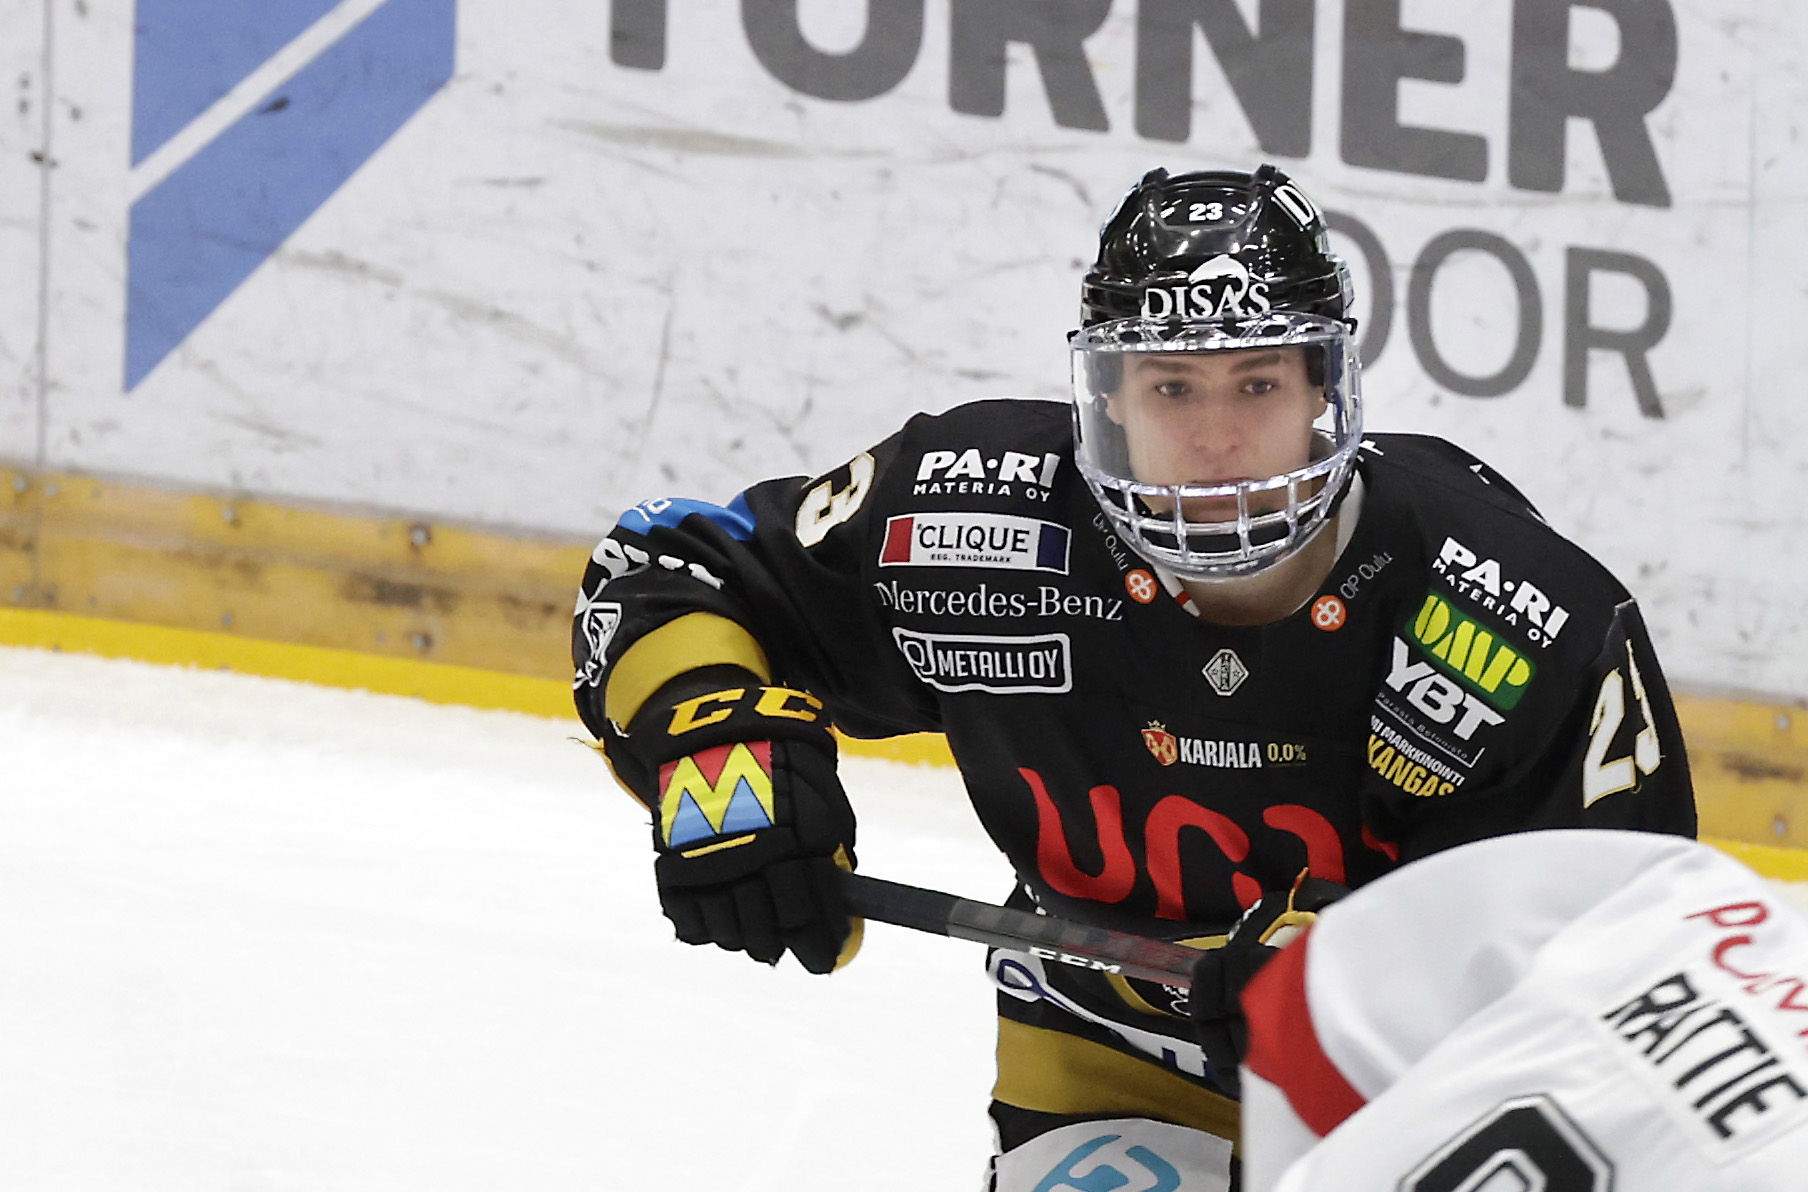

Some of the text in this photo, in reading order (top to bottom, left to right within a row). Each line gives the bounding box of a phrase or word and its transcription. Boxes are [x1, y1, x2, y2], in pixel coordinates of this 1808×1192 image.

[1188, 202, 1223, 221] 23
[1140, 280, 1271, 320] DISAS
[913, 481, 1050, 502] MATERIA OY
[918, 524, 1030, 553] CLIQUE
[956, 554, 1012, 564] TRADEMARK
[1358, 552, 1393, 580] Oulu
[873, 580, 1124, 621] Mercedes-Benz
[1432, 557, 1553, 649] MATERIA OY
[937, 649, 1025, 678] METALLI
[1385, 636, 1506, 741] YBT
[1179, 737, 1263, 768] KARJALA
[1381, 725, 1466, 787] MARKKINOINTI
